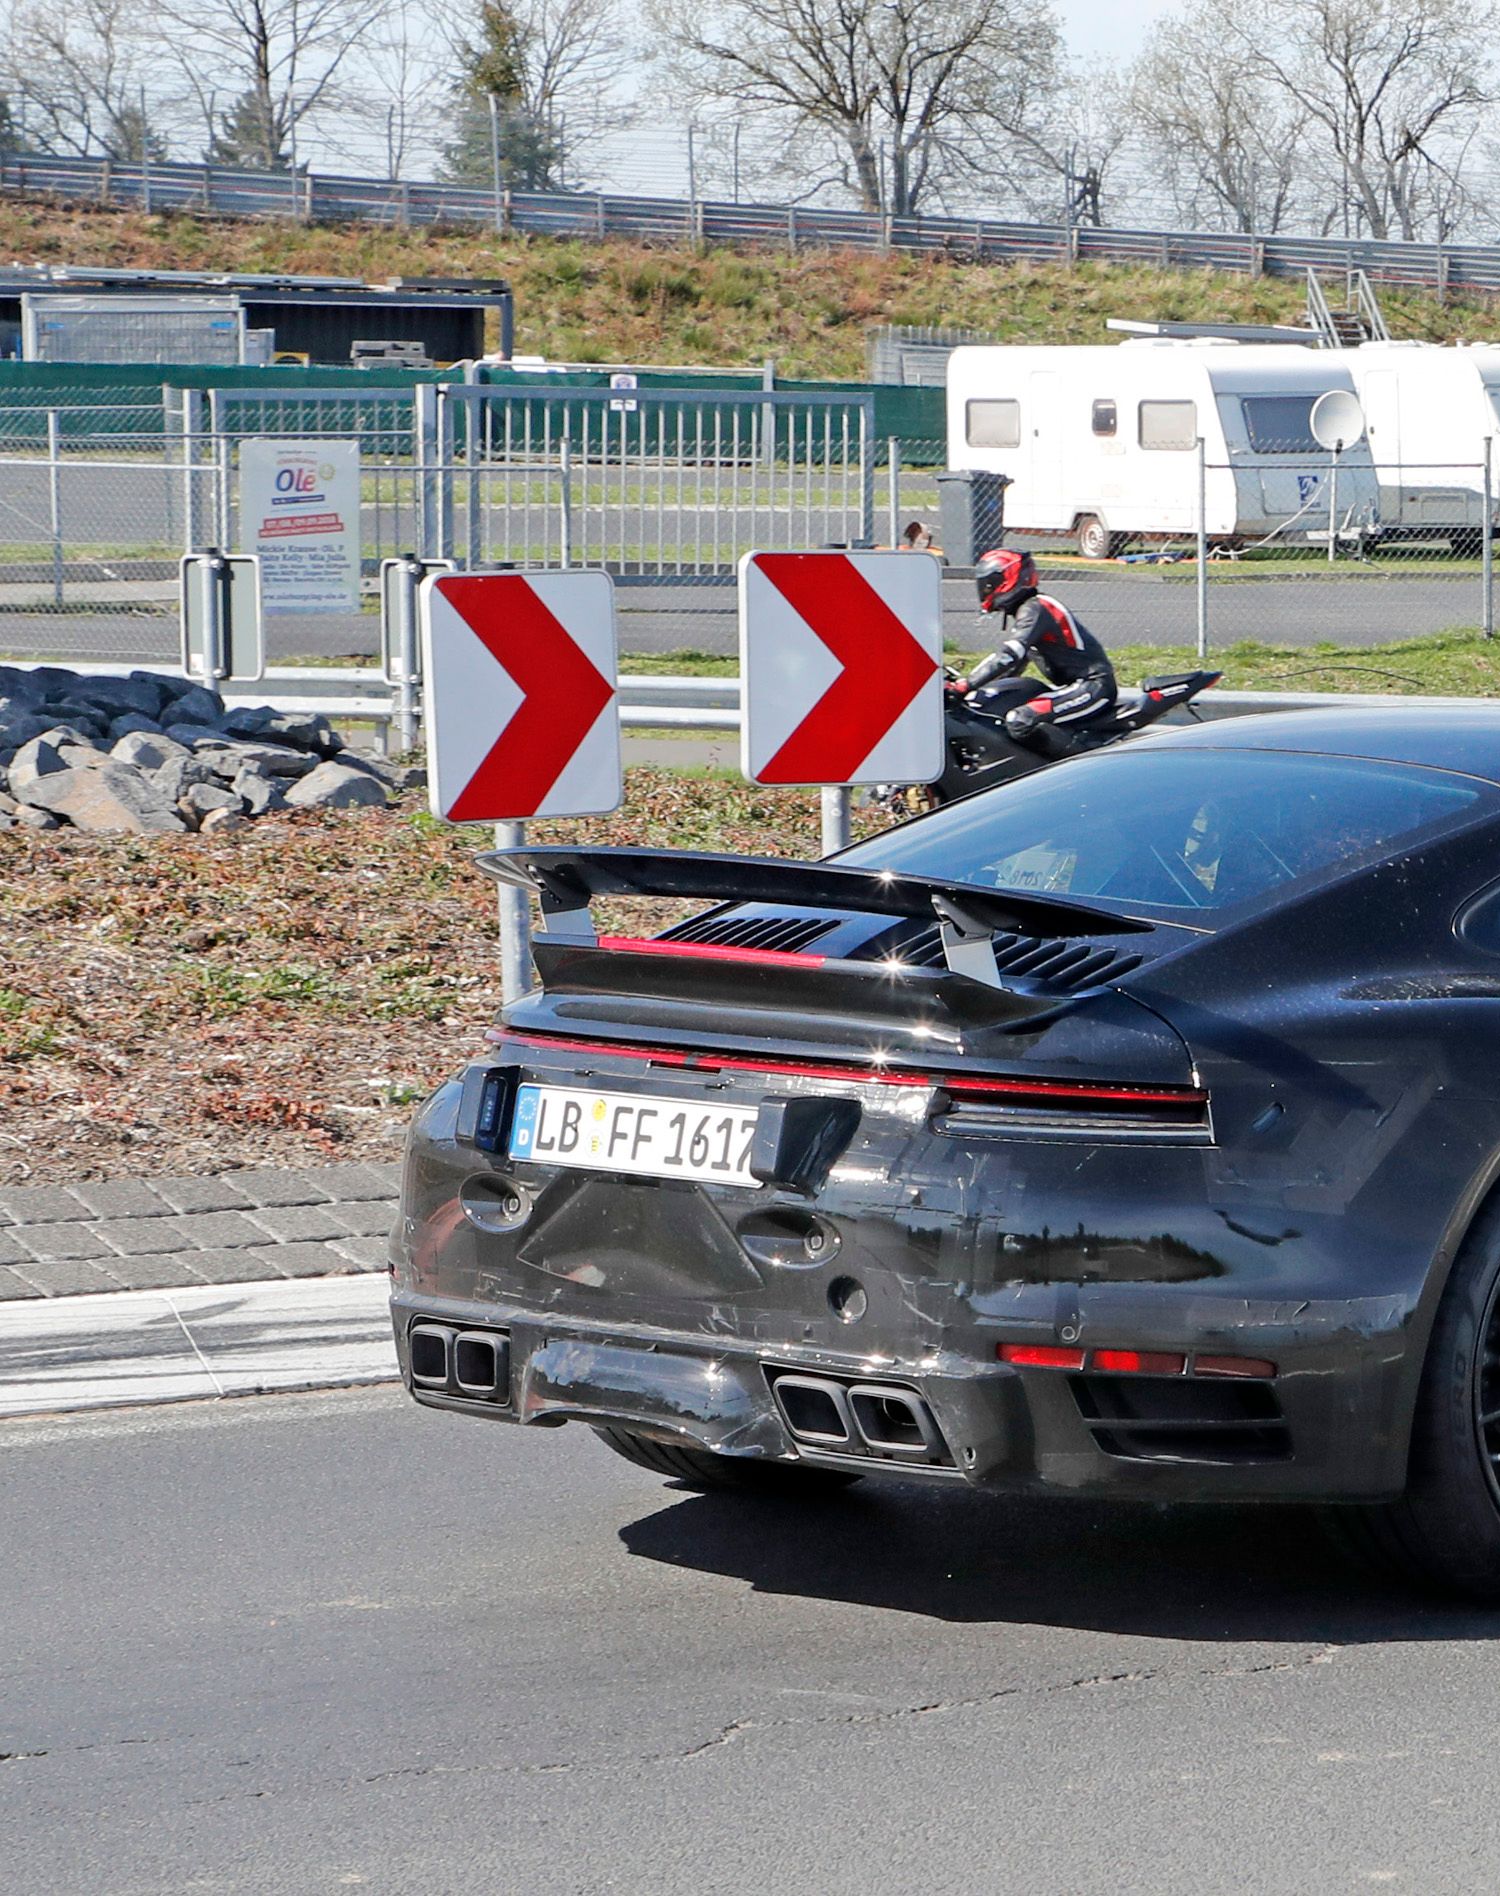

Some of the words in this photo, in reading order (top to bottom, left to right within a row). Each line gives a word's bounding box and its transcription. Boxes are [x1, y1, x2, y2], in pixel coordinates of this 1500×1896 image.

[276, 468, 316, 492] Olé
[518, 1128, 530, 1146] D
[535, 1098, 582, 1154] LB
[608, 1106, 658, 1160] FF
